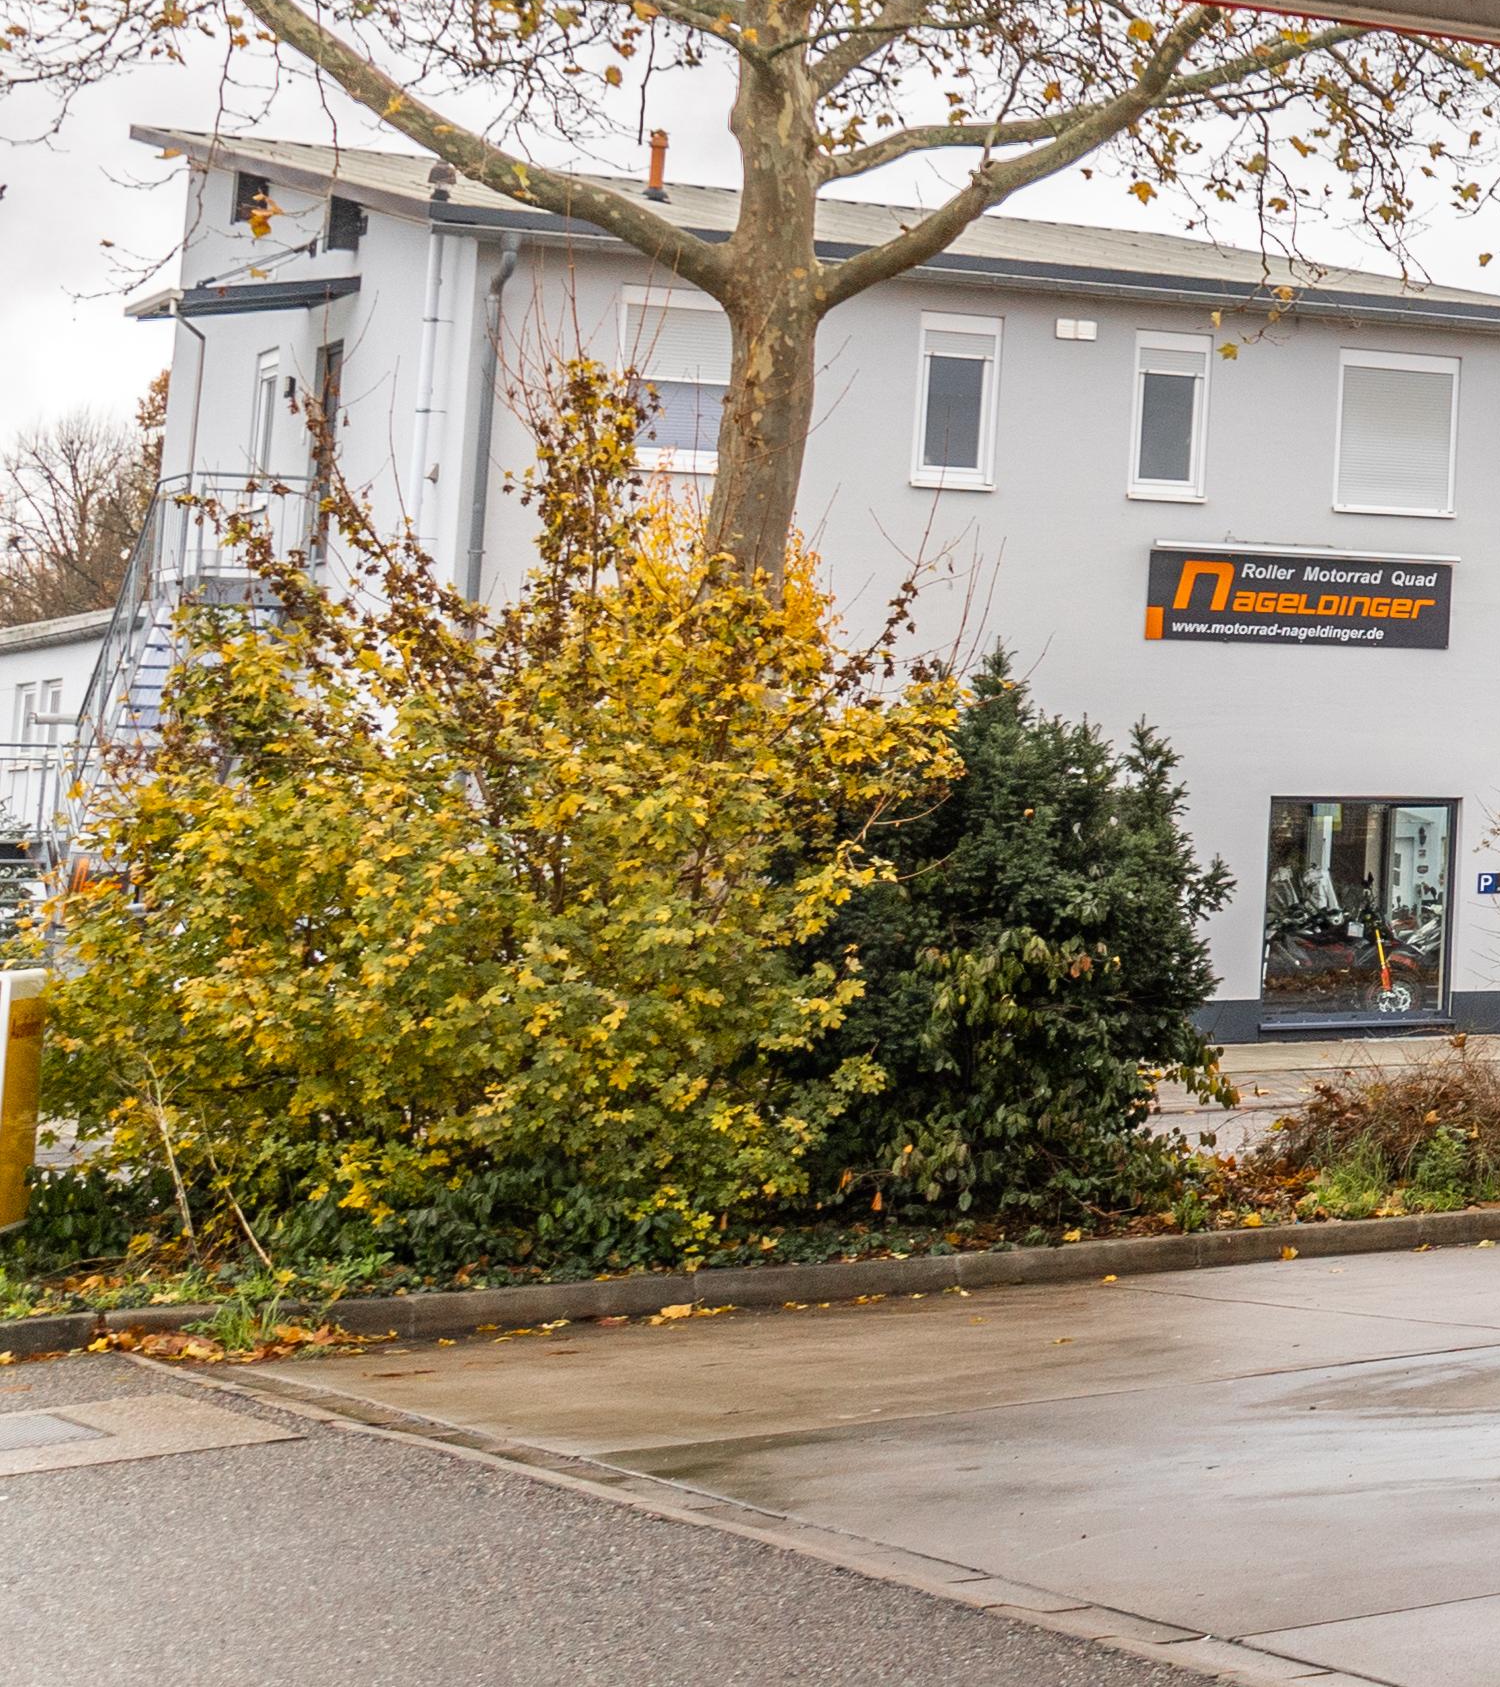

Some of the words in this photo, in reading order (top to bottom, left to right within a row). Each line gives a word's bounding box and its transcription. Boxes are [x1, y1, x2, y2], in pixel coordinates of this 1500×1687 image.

[1241, 563, 1295, 581] Roller
[1303, 566, 1383, 585] Motorrad
[1391, 570, 1437, 588] Quad
[1172, 621, 1385, 640] www.motorrad-nageldinger.de
[1480, 875, 1493, 892] P
